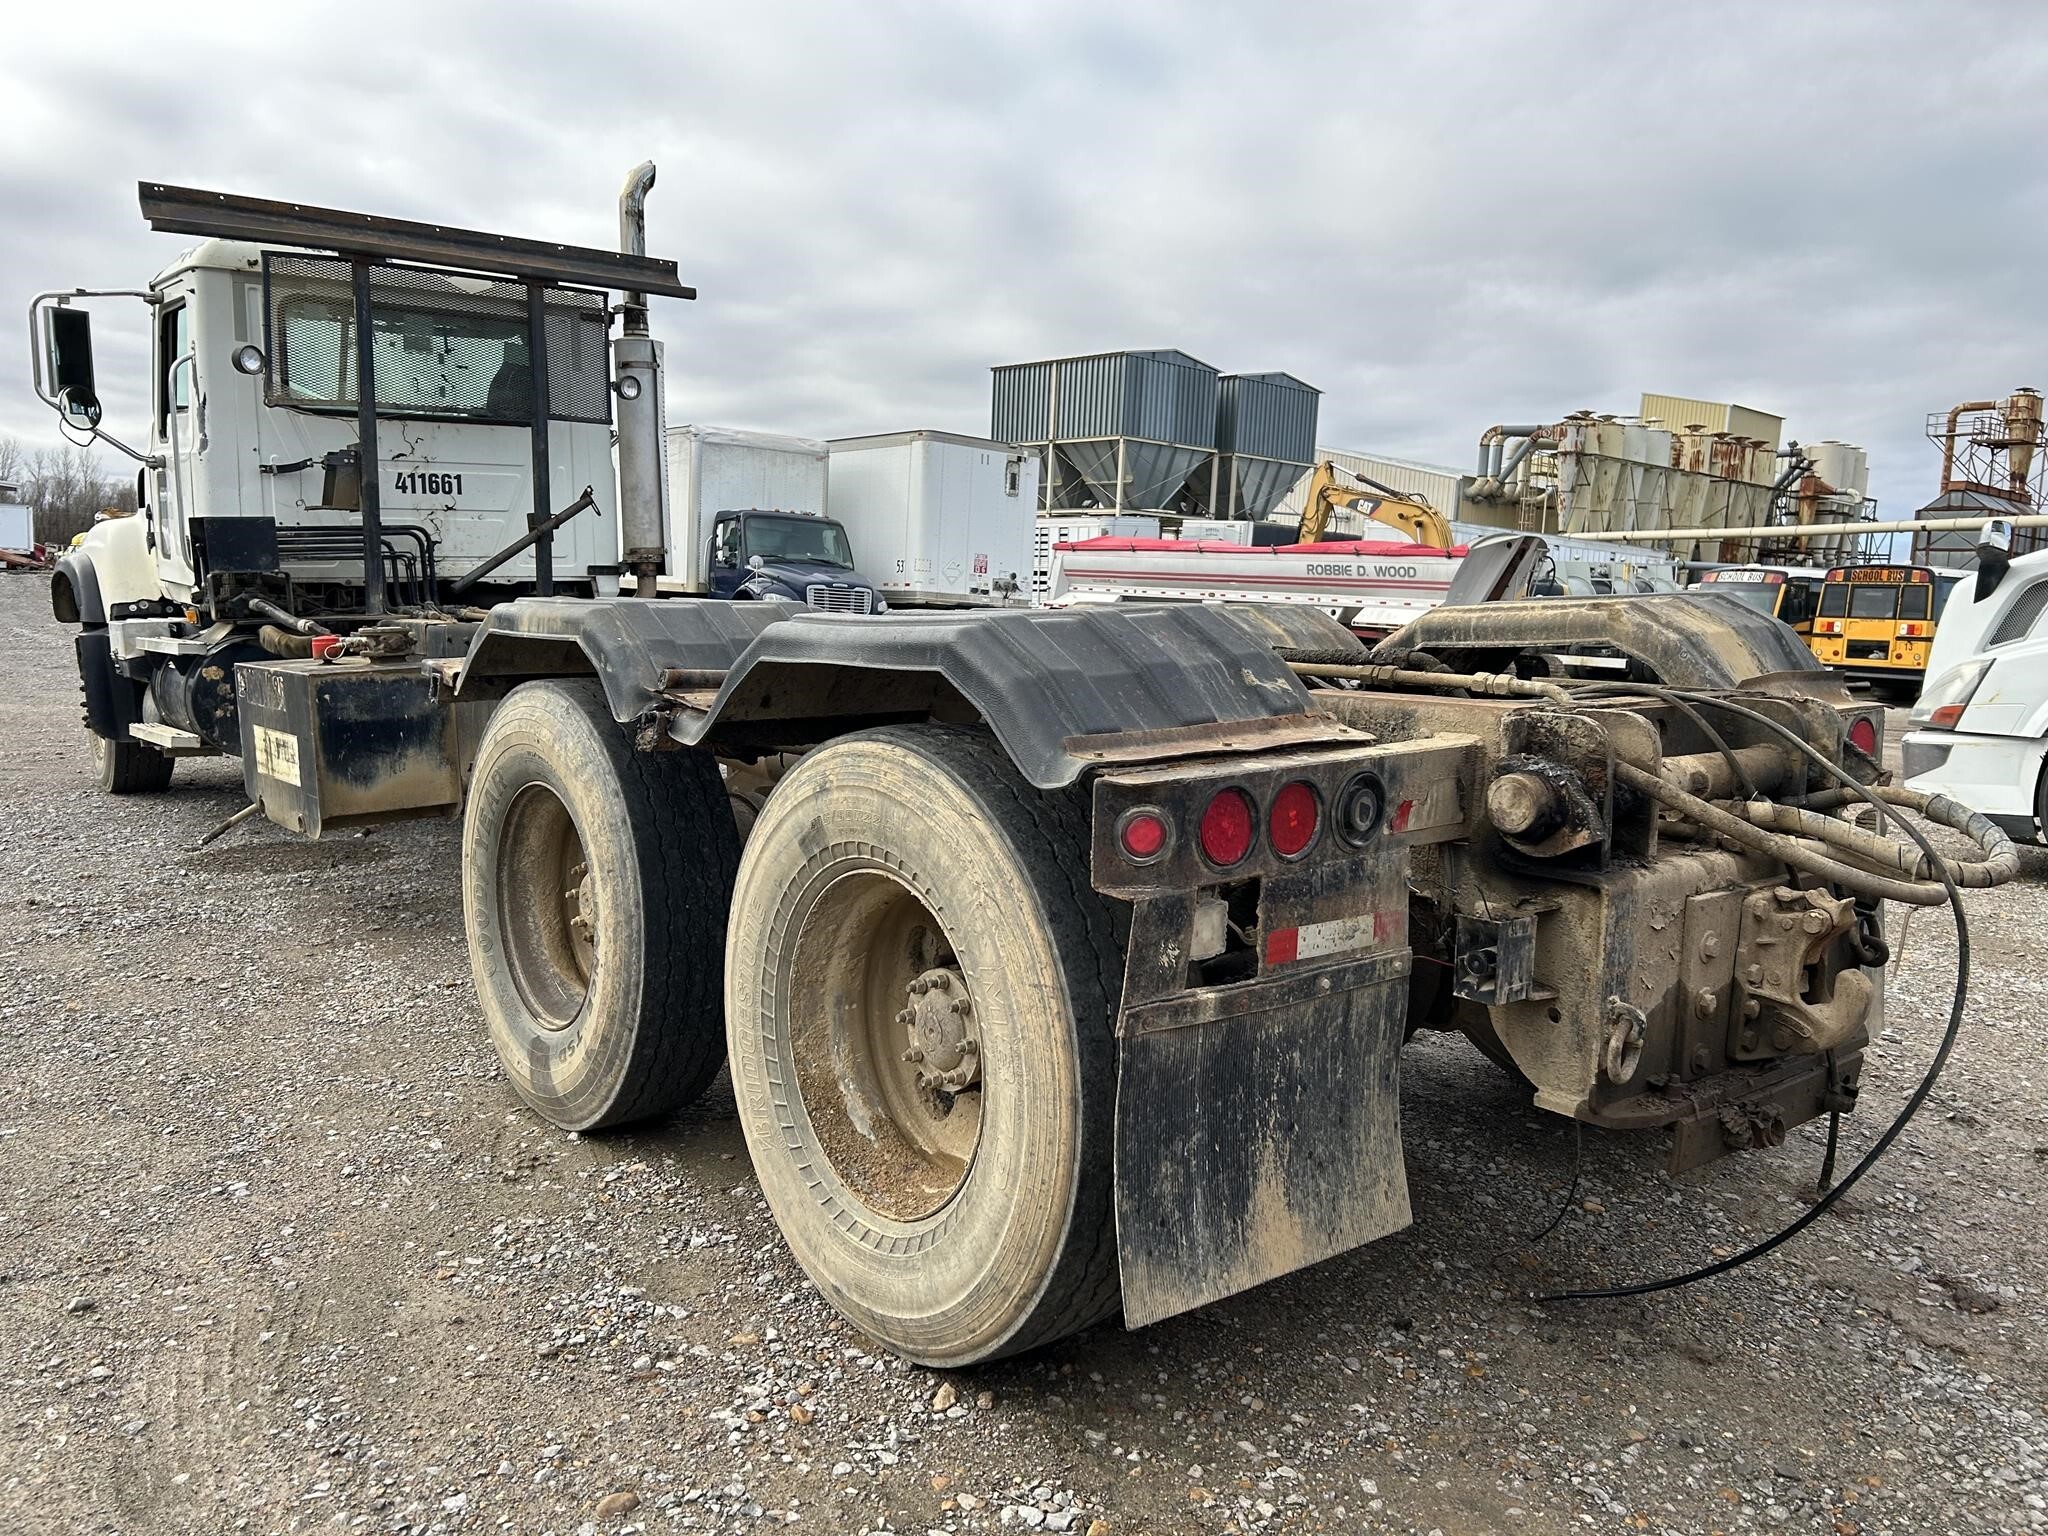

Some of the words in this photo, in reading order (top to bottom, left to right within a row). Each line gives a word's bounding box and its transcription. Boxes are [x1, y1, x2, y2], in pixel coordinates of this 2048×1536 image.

[395, 472, 463, 495] 411661
[1356, 499, 1374, 515] CAT
[896, 559, 905, 574] 53
[1306, 563, 1352, 577] ROBBIE
[1357, 565, 1369, 577] D.
[1374, 565, 1417, 578] WOOD
[1718, 571, 1745, 582] SCHOOL
[1747, 571, 1763, 582] BUS
[1851, 570, 1884, 582] SCHOOL
[1887, 570, 1904, 582] BUS
[1904, 643, 1913, 652] 13
[735, 894, 774, 1153] BRIDGESTONE
